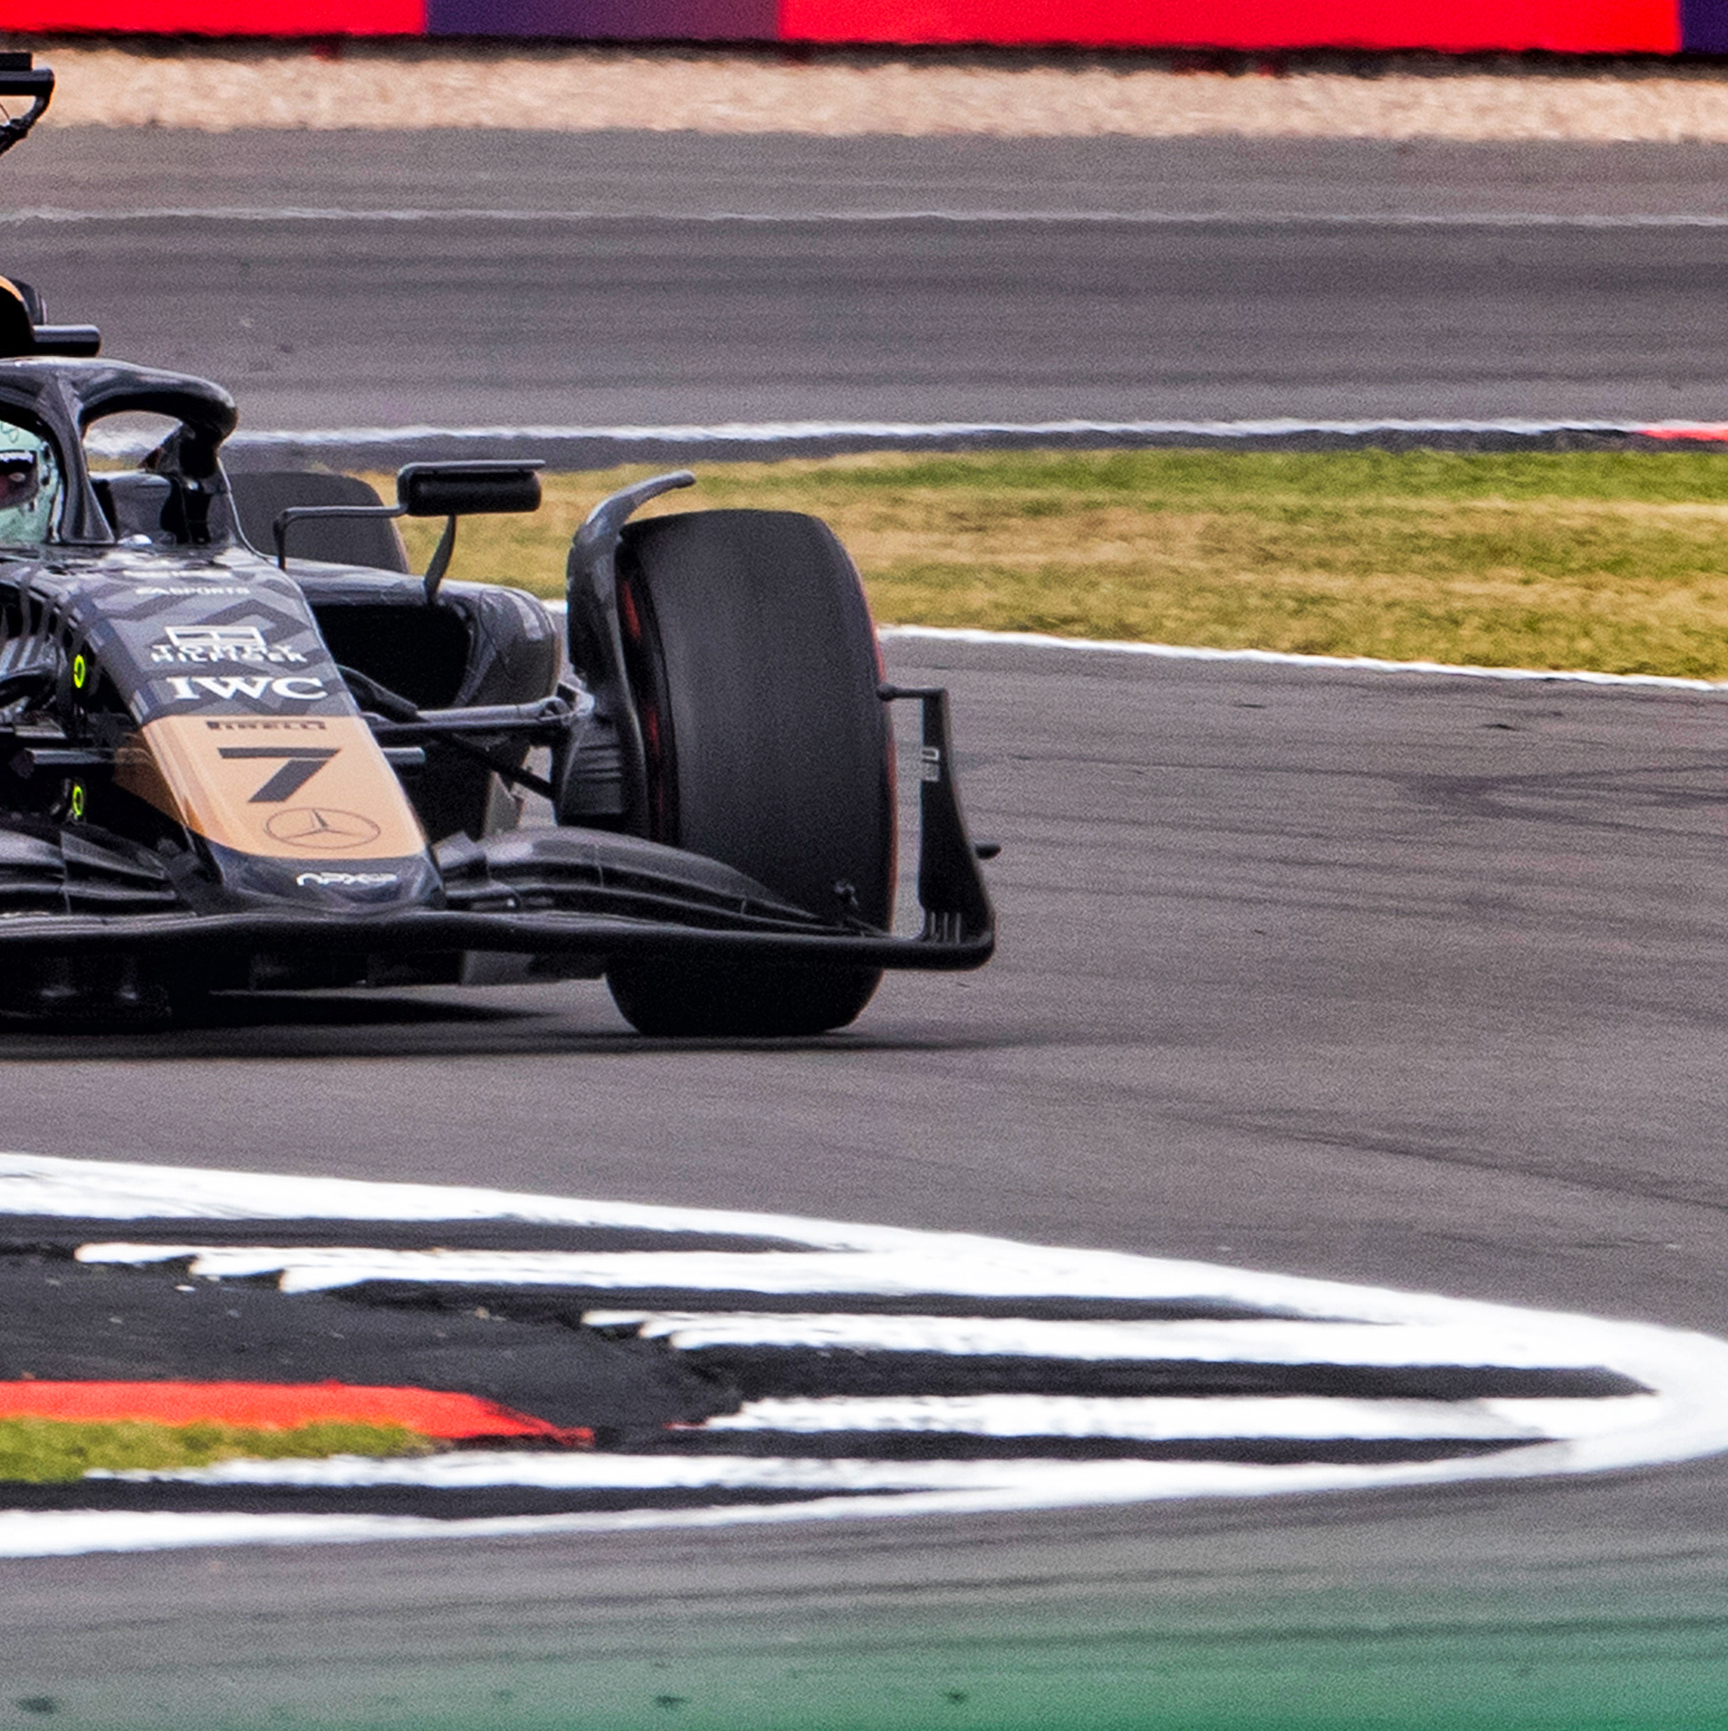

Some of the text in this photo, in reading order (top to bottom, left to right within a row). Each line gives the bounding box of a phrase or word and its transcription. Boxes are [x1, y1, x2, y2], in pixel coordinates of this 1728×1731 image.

[150, 652, 308, 663] HILFIGER
[166, 676, 329, 700] IWC
[206, 721, 327, 730] PIRELLI
[217, 746, 342, 804] 7
